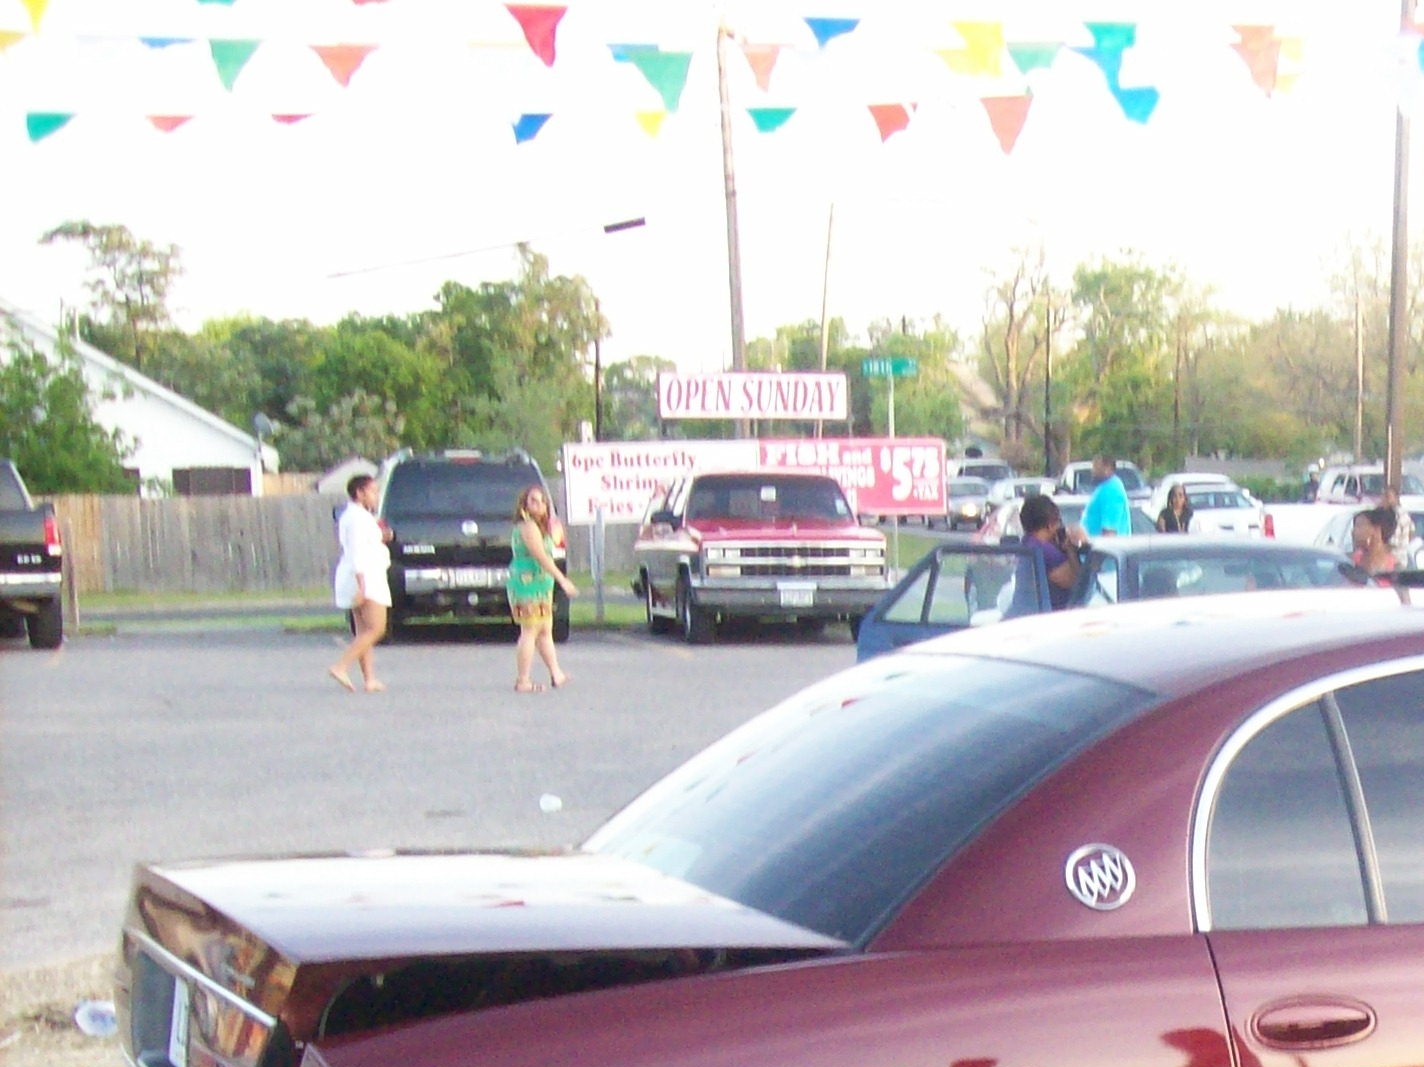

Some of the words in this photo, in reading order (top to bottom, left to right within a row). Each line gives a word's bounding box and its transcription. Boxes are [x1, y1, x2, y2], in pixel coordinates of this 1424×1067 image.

[666, 377, 732, 412] OPEN
[740, 377, 840, 413] SUNDAY
[571, 453, 604, 473] 6pc
[610, 450, 697, 470] Butterfly
[765, 443, 840, 466] FISH
